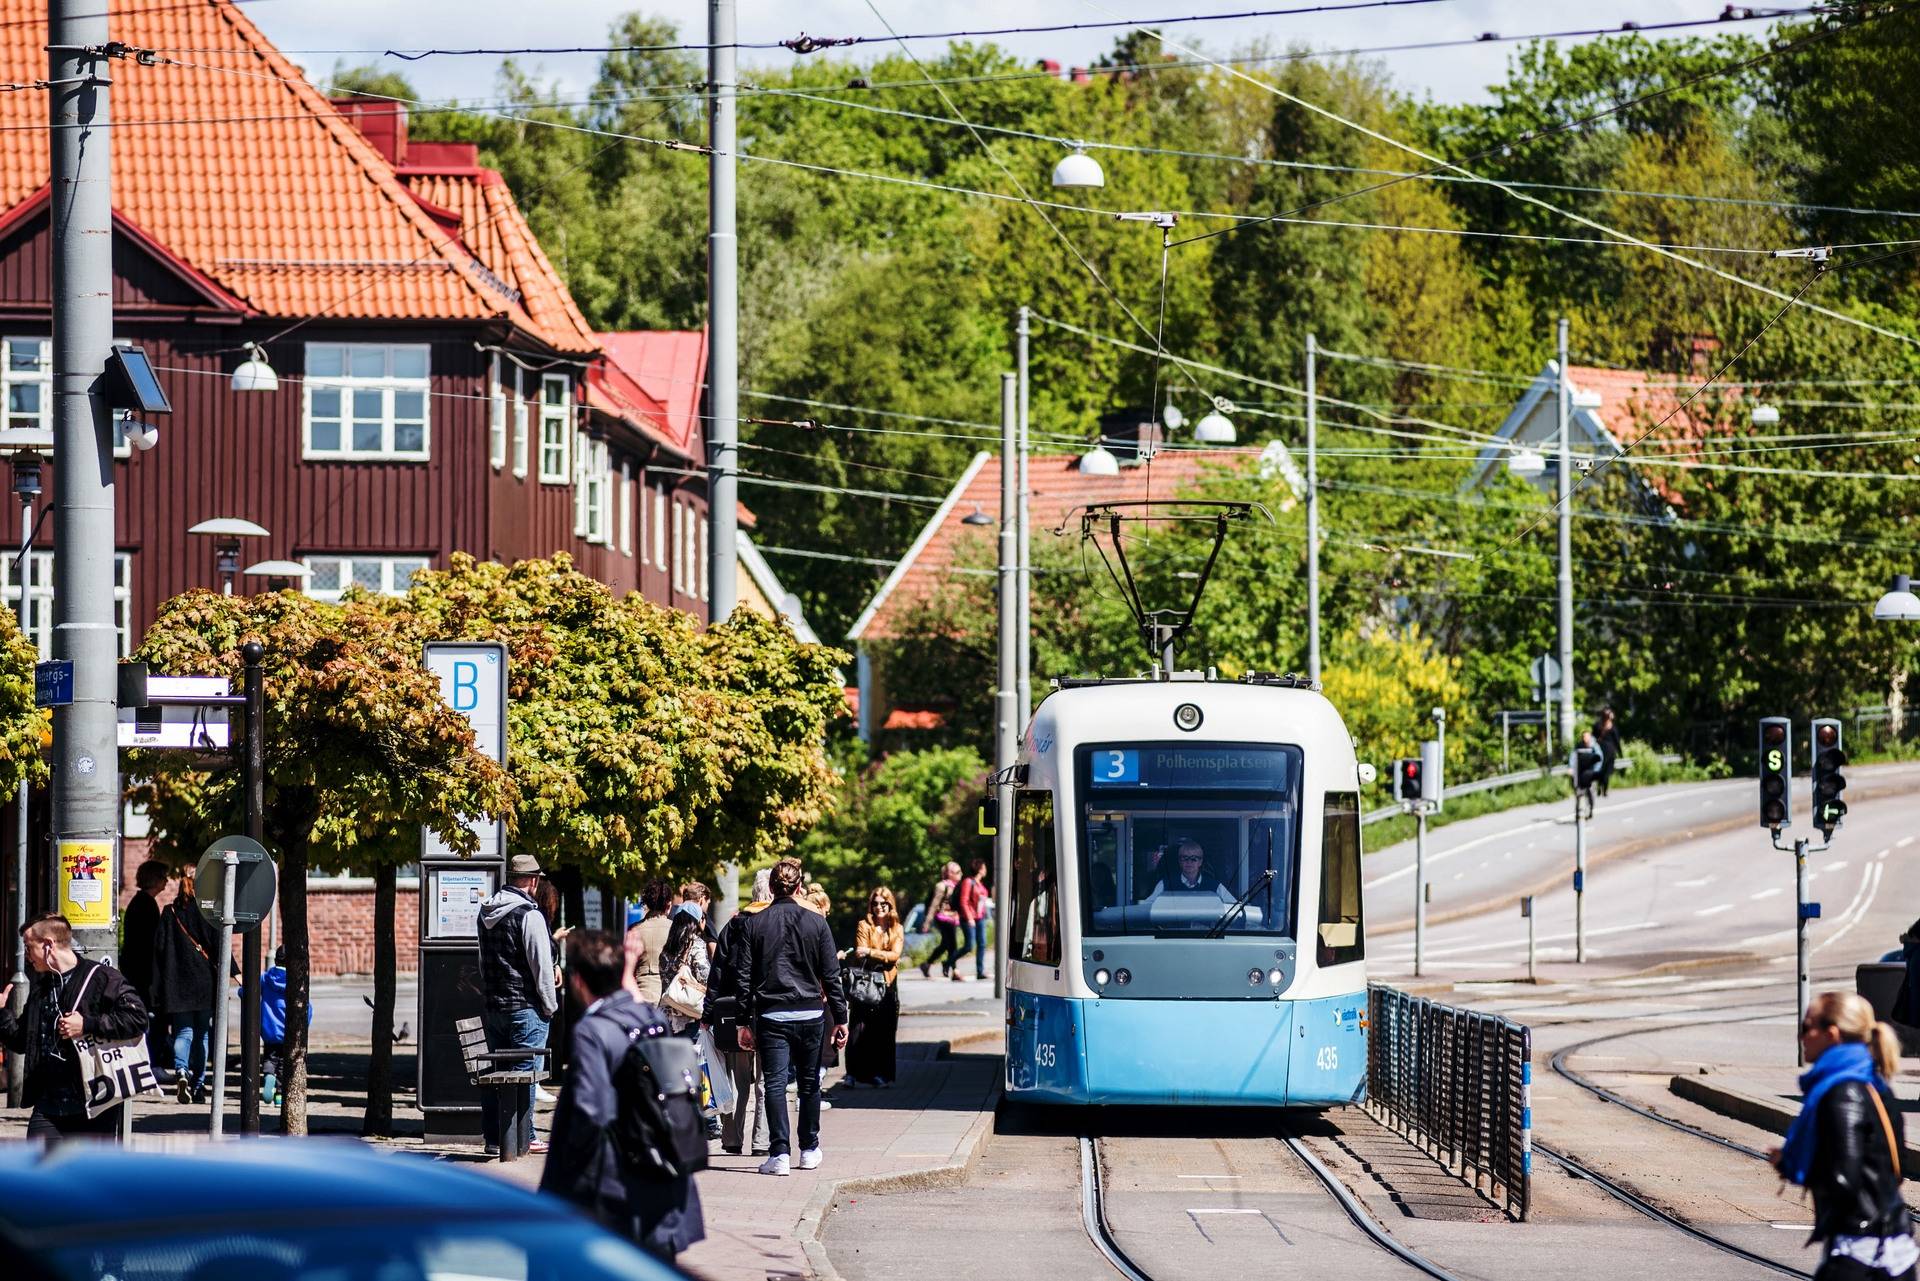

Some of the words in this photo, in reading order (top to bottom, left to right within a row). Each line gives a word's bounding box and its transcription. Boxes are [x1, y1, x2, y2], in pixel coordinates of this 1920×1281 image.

[454, 661, 478, 711] B
[1108, 750, 1125, 778] 3
[1157, 754, 1273, 772] Polhemsplatsen
[1768, 749, 1782, 771] S
[101, 1049, 123, 1063] OR
[1035, 1043, 1056, 1067] 435
[1317, 1046, 1338, 1071] 435
[88, 1061, 157, 1108] DIE
